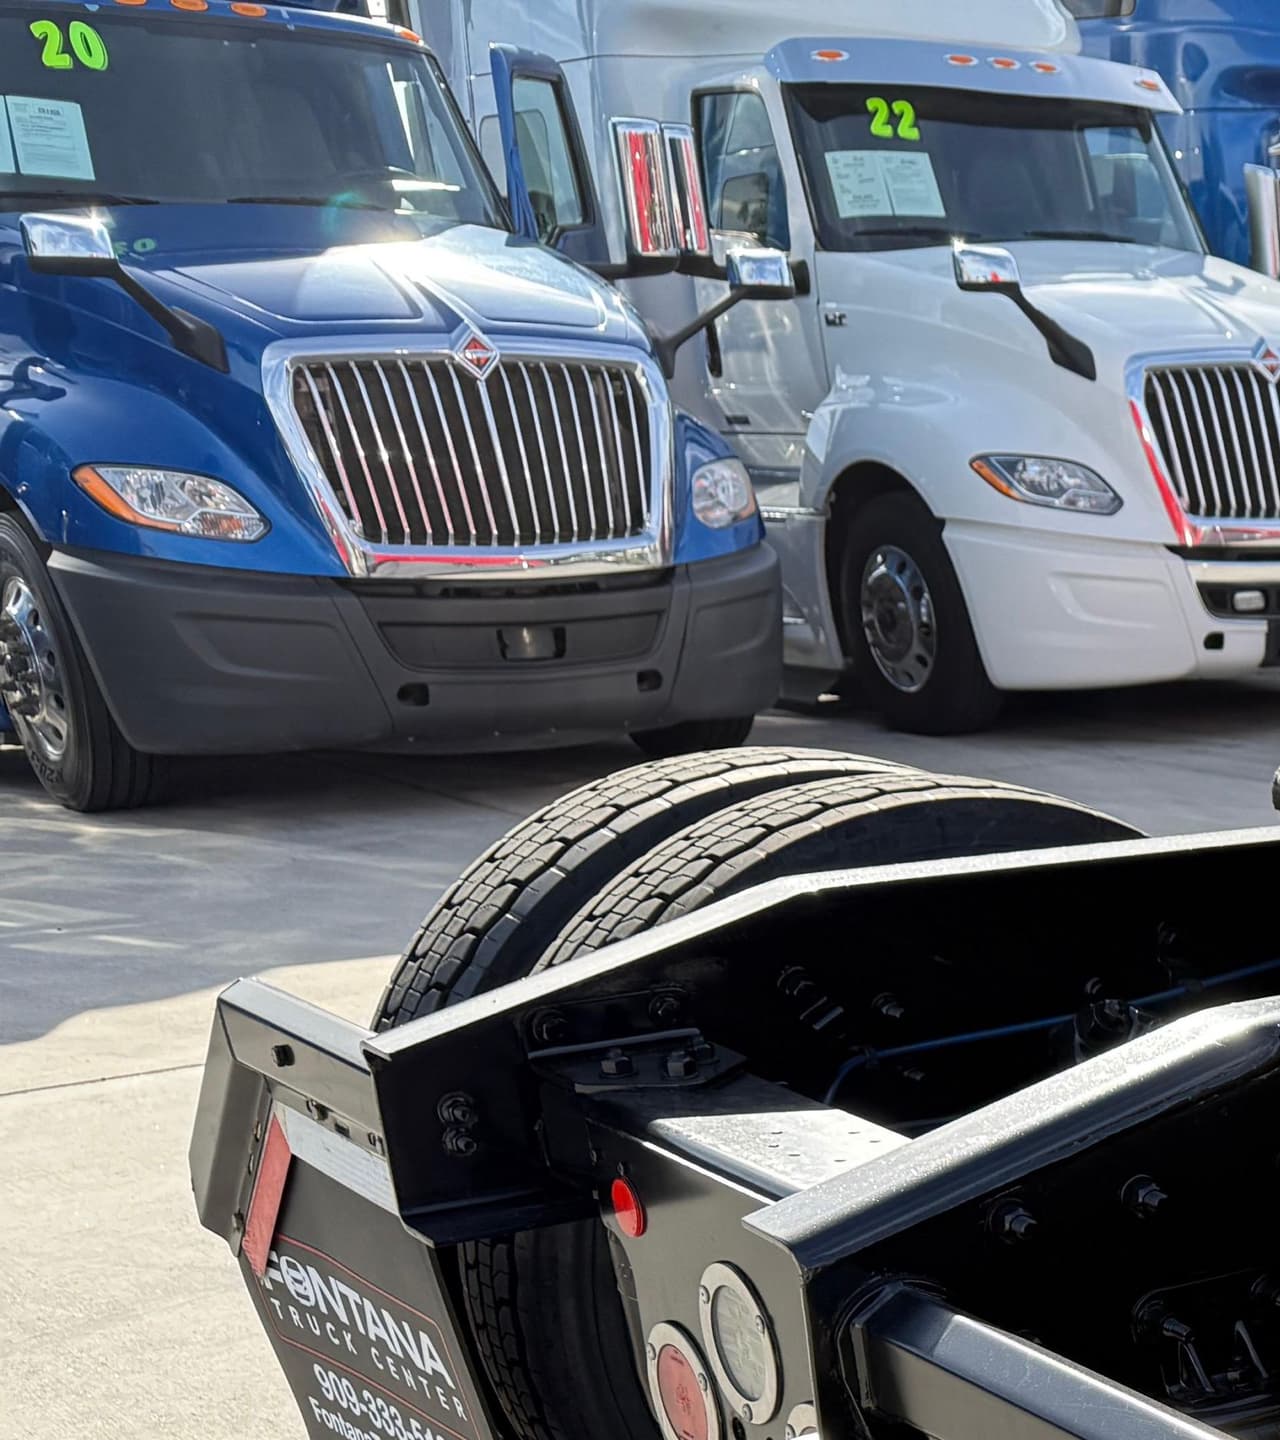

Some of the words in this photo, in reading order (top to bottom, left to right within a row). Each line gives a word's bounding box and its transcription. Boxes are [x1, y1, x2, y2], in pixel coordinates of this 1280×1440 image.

[30, 20, 108, 71] 20
[865, 96, 920, 140] 22
[270, 1297, 358, 1354] TRUCK
[371, 1346, 468, 1421] CENTER
